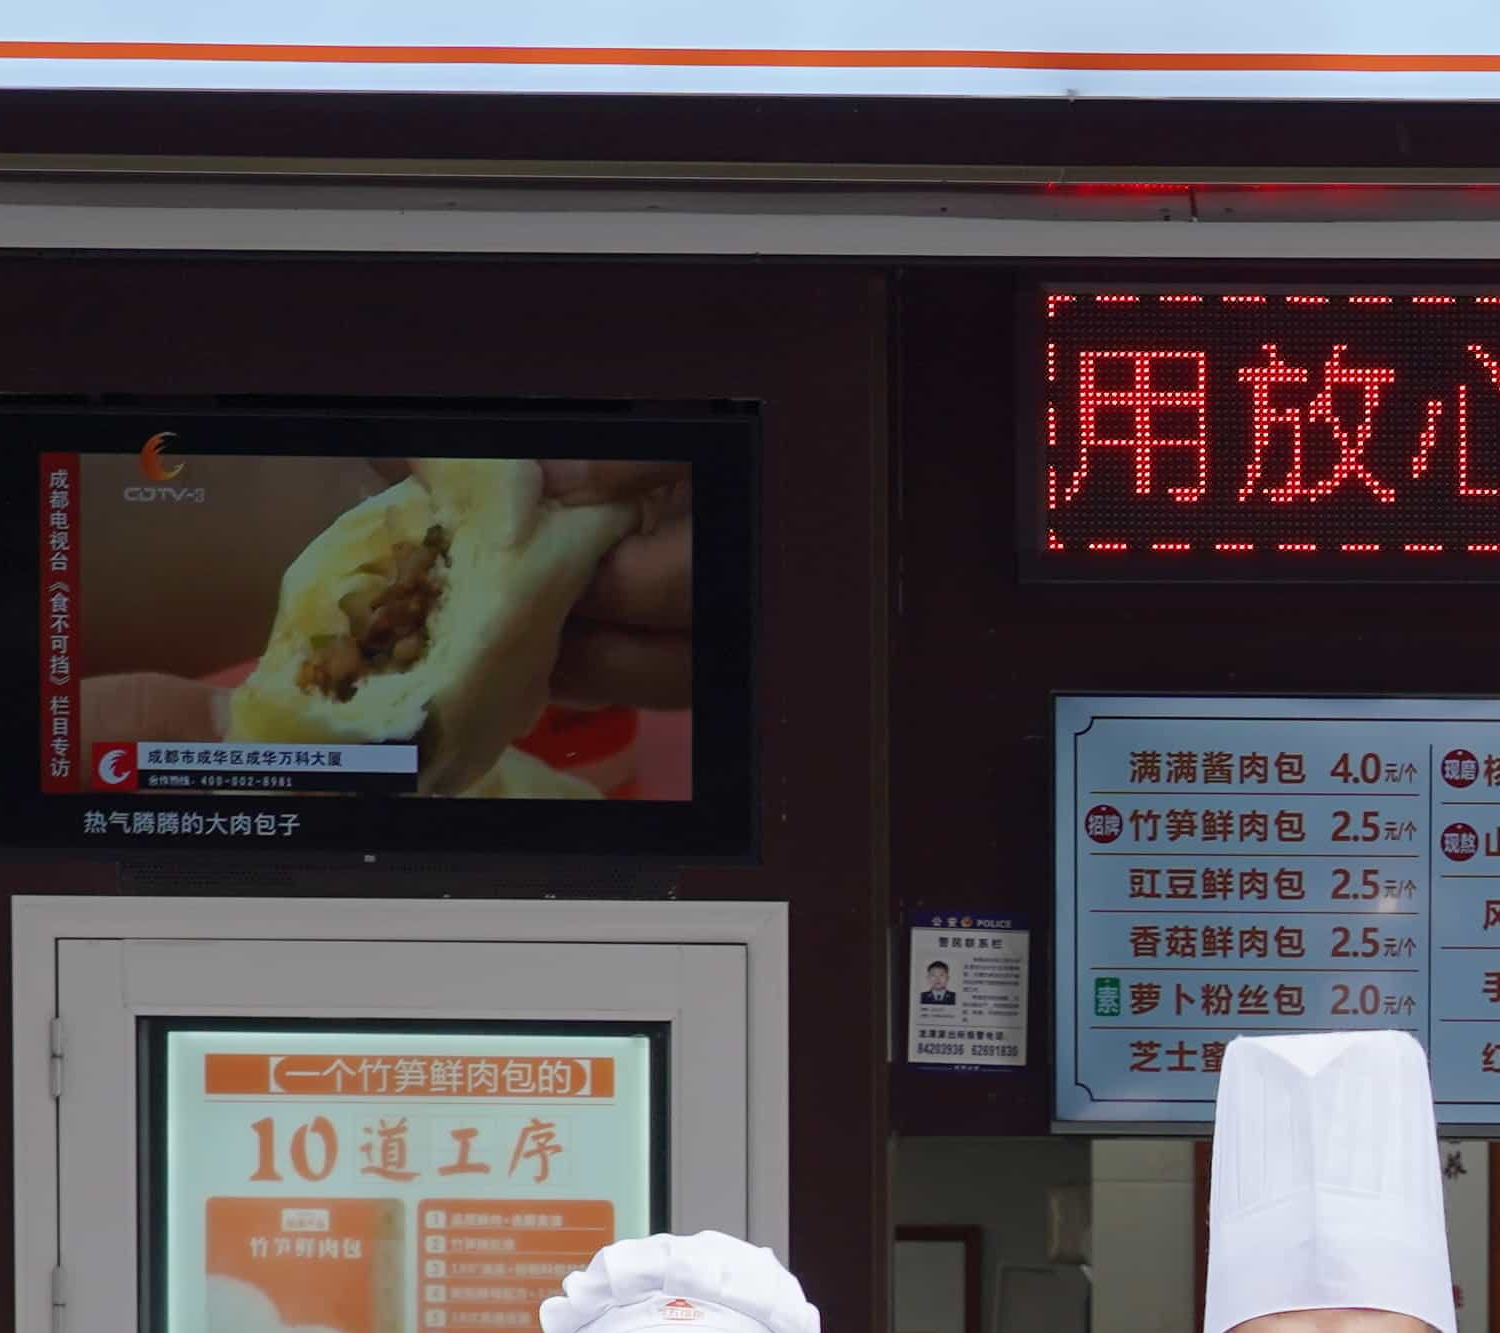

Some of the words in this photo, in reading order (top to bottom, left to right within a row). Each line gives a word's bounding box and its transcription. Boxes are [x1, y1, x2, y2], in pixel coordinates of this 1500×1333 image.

[1129, 751, 1306, 785] 满满酱肉包
[84, 810, 301, 836] 热气腾腾的大肉包子
[1129, 809, 1306, 843] 竹笋鲜肉包
[1129, 867, 1306, 900] 豇豆鲜肉包
[1129, 925, 1306, 959] 香菇鲜肉包
[1129, 982, 1306, 1016] 萝卜粉丝包
[269, 1057, 594, 1096] 【一个竹笋鲜肉包的】
